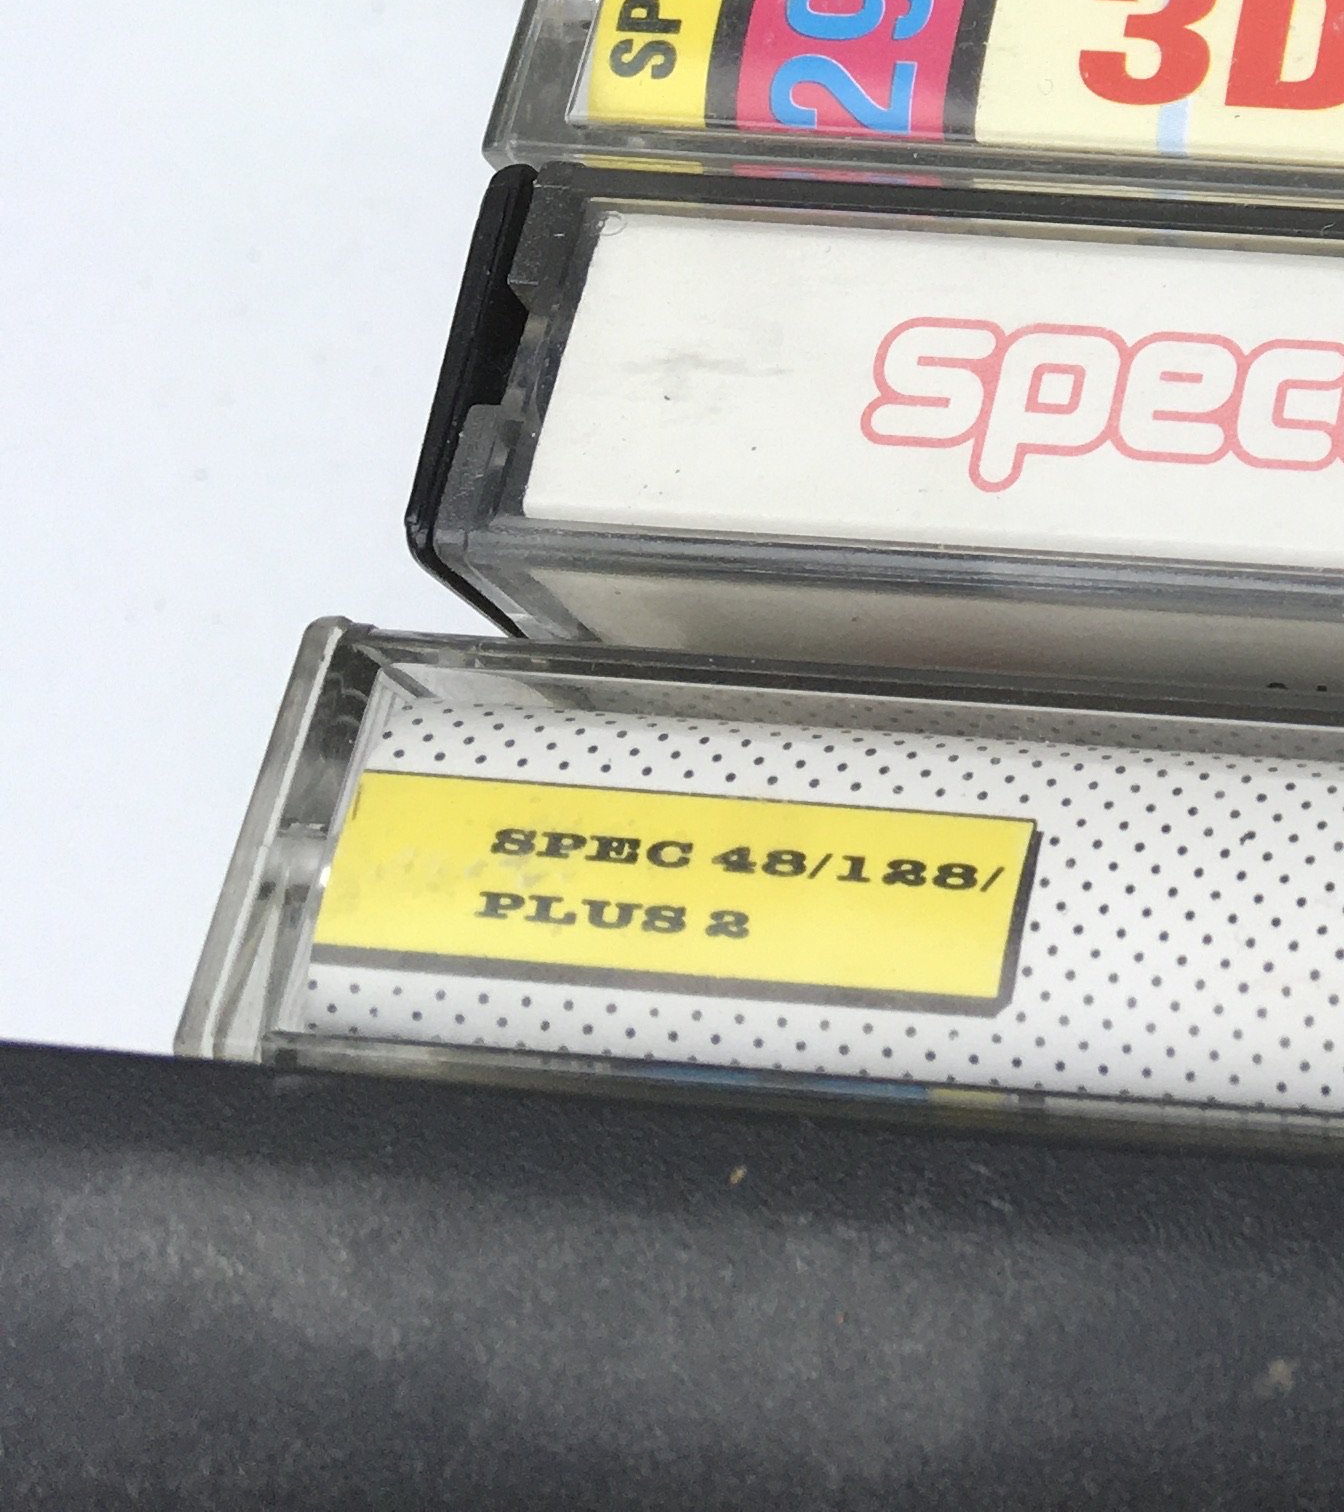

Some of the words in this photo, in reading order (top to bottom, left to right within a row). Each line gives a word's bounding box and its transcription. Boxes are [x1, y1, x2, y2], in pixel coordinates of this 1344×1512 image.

[489, 827, 694, 870] SPEC
[711, 845, 1006, 893] 48/128/
[475, 891, 686, 934] PLUS
[705, 909, 751, 941] 2
